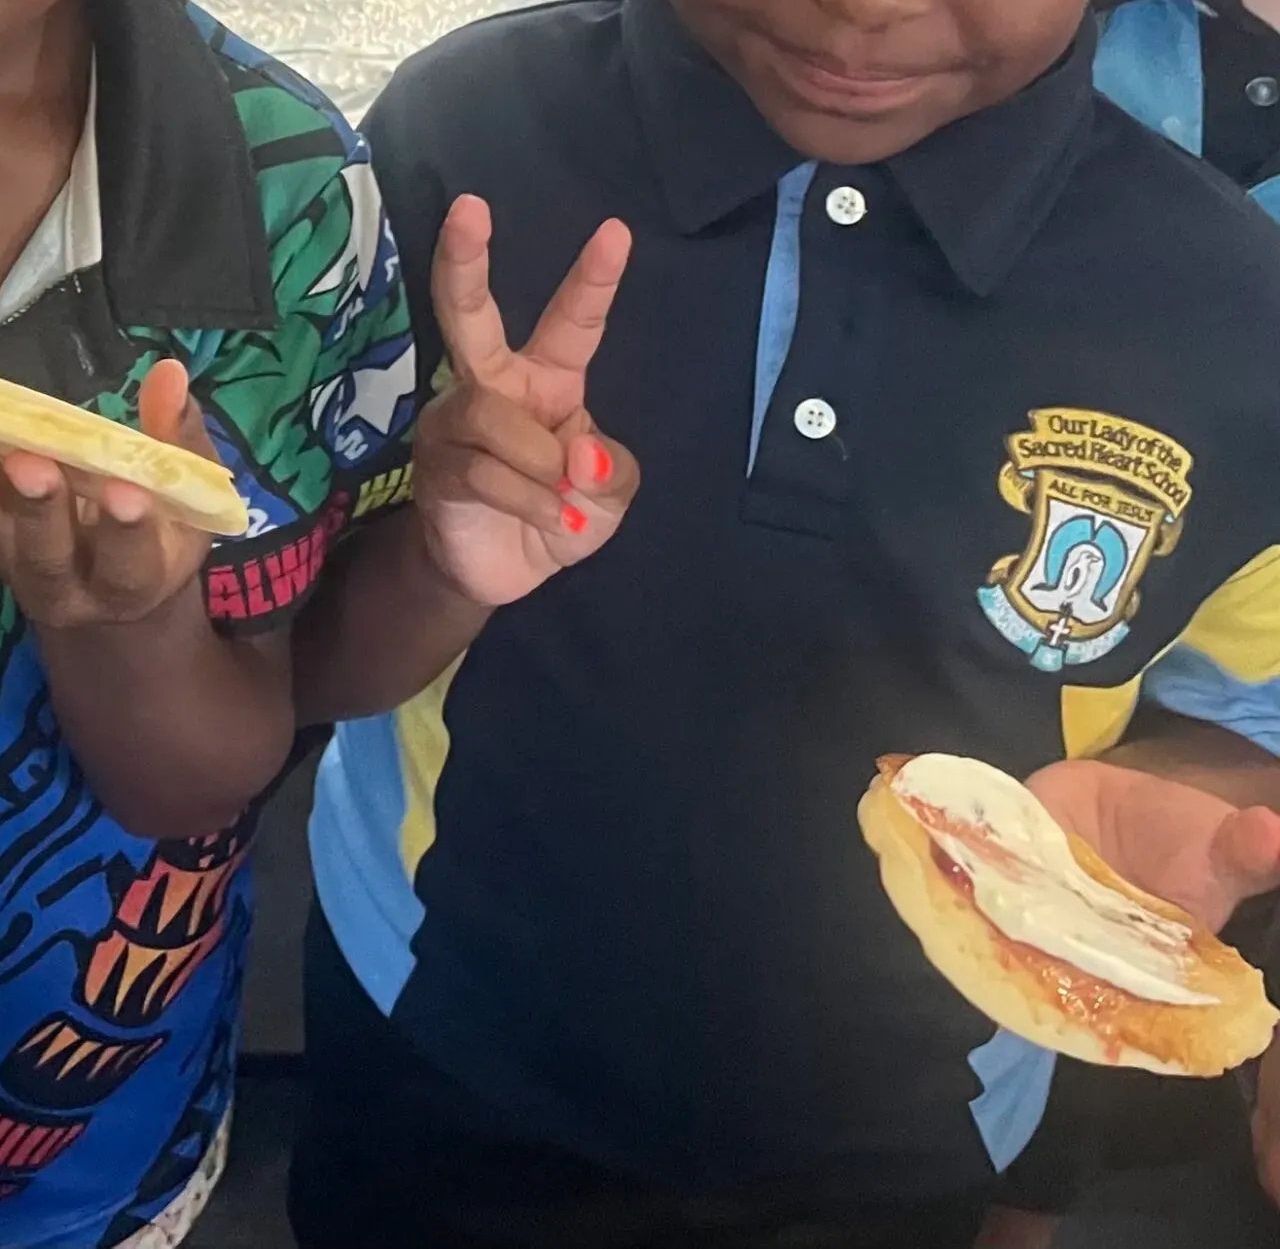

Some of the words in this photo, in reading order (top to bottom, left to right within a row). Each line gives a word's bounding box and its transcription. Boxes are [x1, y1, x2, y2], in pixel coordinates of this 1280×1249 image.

[1048, 415, 1089, 435] Our
[1090, 419, 1138, 451] Lady
[1019, 439, 1087, 461] Sacred
[1090, 440, 1143, 478] Heart
[1141, 462, 1188, 507] School
[1049, 478, 1079, 499] ALL
[1081, 489, 1111, 507] FOR
